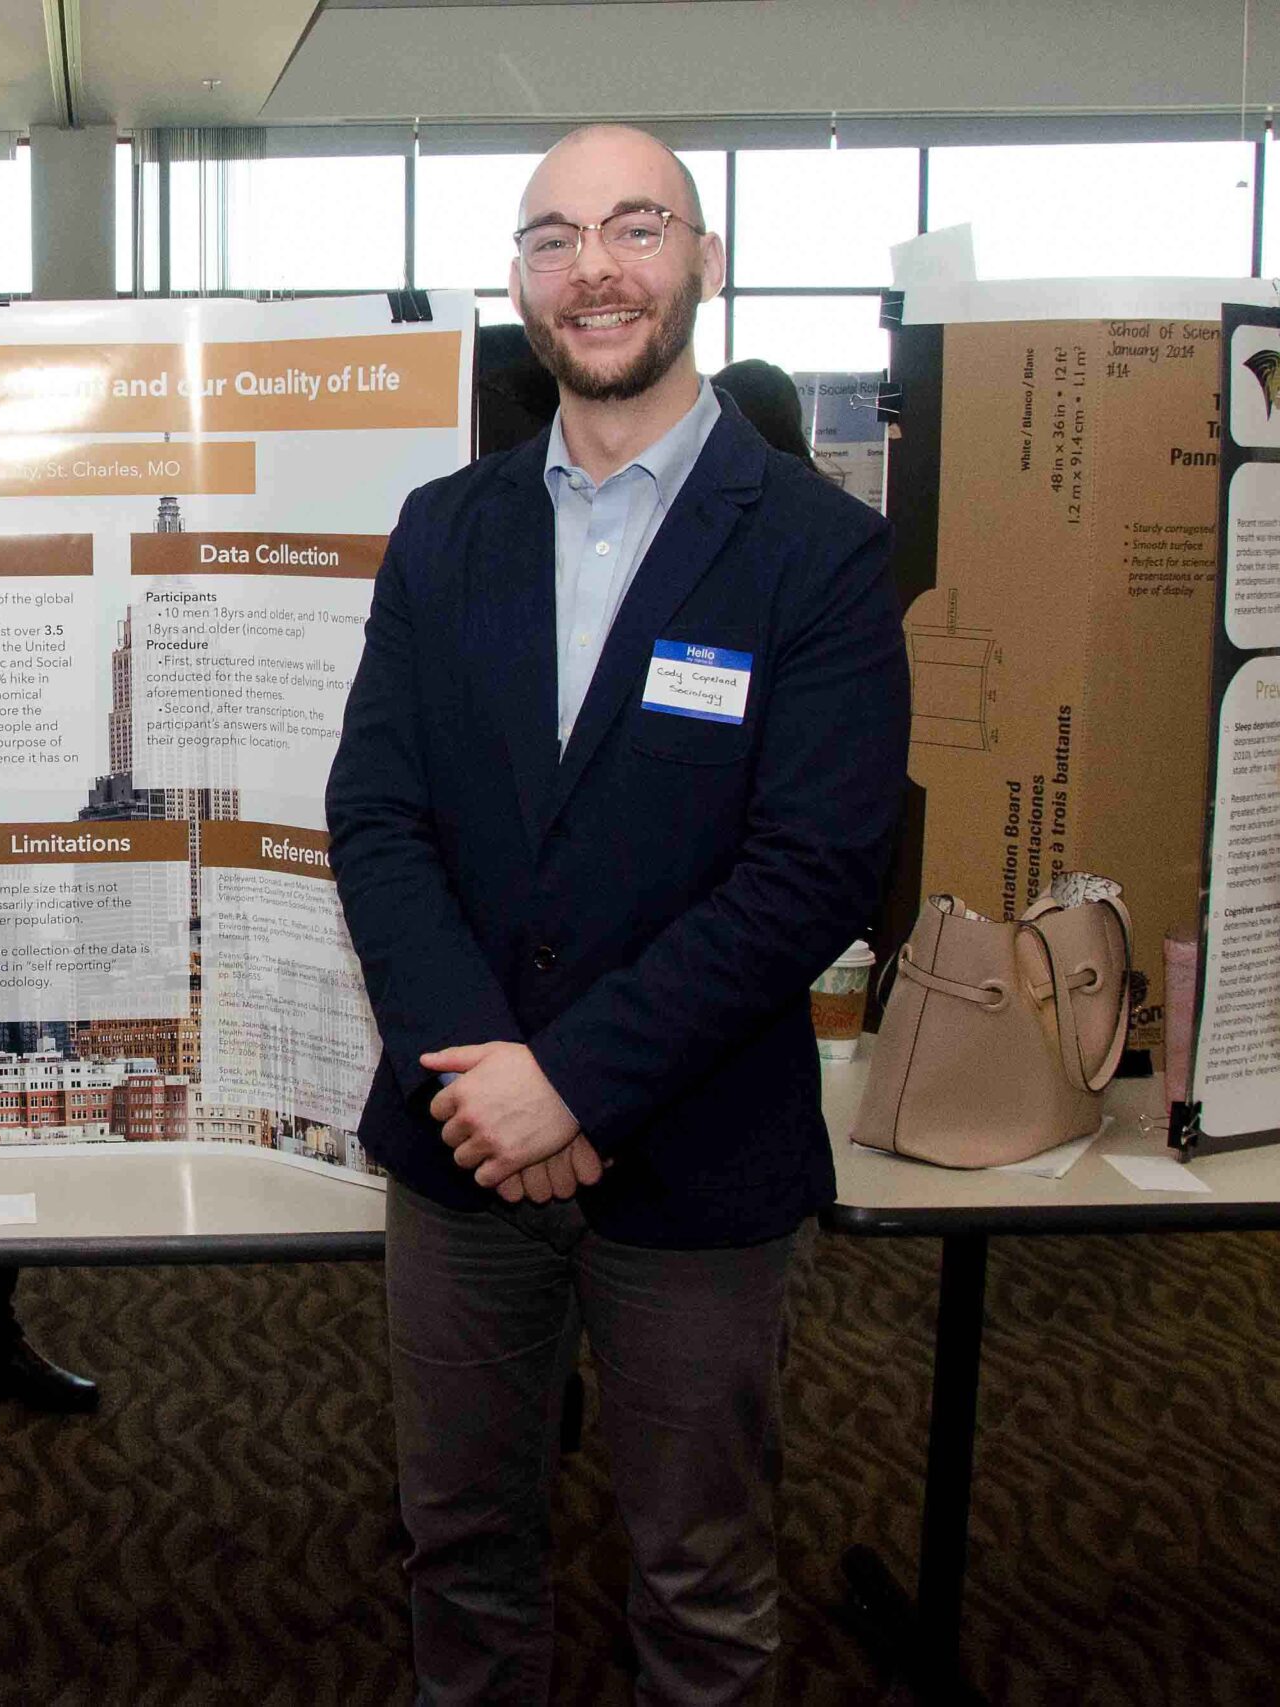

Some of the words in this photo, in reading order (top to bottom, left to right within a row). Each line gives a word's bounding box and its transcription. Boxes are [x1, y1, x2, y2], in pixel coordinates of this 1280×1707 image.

[1109, 321, 1150, 338] School
[1160, 322, 1173, 339] of
[1183, 325, 1220, 340] Scien
[1107, 341, 1159, 363] January
[1166, 345, 1195, 358] 2014
[1024, 348, 1035, 379] Blanc
[1106, 363, 1131, 378] #14
[113, 372, 168, 398] and
[234, 368, 320, 401] Quality
[327, 364, 352, 393] of
[357, 364, 400, 392] Life
[1055, 366, 1067, 381] 12
[1073, 372, 1085, 387] 1.1
[1022, 390, 1033, 428] Blanco
[1054, 405, 1065, 418] in
[1053, 421, 1065, 439] 36
[1075, 410, 1084, 433] cm
[1021, 439, 1031, 472] White
[1056, 445, 1064, 453] x
[1070, 437, 1083, 466] 91.4
[1170, 448, 1220, 466] Pann
[46, 462, 68, 479] St.
[72, 461, 142, 480] Charles,
[148, 460, 181, 477] MO
[1052, 458, 1064, 472] in
[1051, 473, 1063, 493] 48
[1073, 471, 1081, 480] x
[1072, 485, 1081, 499] m
[1068, 504, 1081, 524] 1.2
[200, 545, 250, 564] Data
[255, 544, 339, 567] Collection
[146, 592, 217, 604] Participants
[43, 625, 64, 636] 3.5
[147, 624, 179, 638] 18yrs
[182, 623, 206, 635] and
[208, 623, 240, 635] older
[242, 623, 284, 637] (income
[285, 627, 305, 639] cap)
[146, 639, 209, 651] Procedure
[687, 646, 715, 660] Hello
[657, 667, 683, 685] Cody
[691, 672, 737, 687] Copeland
[1052, 704, 1072, 785] battants
[1005, 780, 1022, 838] Board
[1051, 790, 1067, 836] trois
[10, 834, 131, 855] Limitations
[1049, 841, 1065, 854] à
[33, 883, 56, 895] size
[58, 882, 82, 894] that
[85, 882, 95, 893] is
[97, 882, 118, 893] not
[1002, 844, 1019, 922] entation
[36, 898, 95, 910] indicative
[97, 897, 112, 909] of
[113, 897, 132, 909] the
[15, 913, 84, 928] population.
[11, 945, 69, 957] collection
[72, 944, 86, 955] of
[88, 943, 108, 955] the
[111, 943, 137, 955] data
[140, 943, 150, 954] is
[12, 960, 24, 972] in
